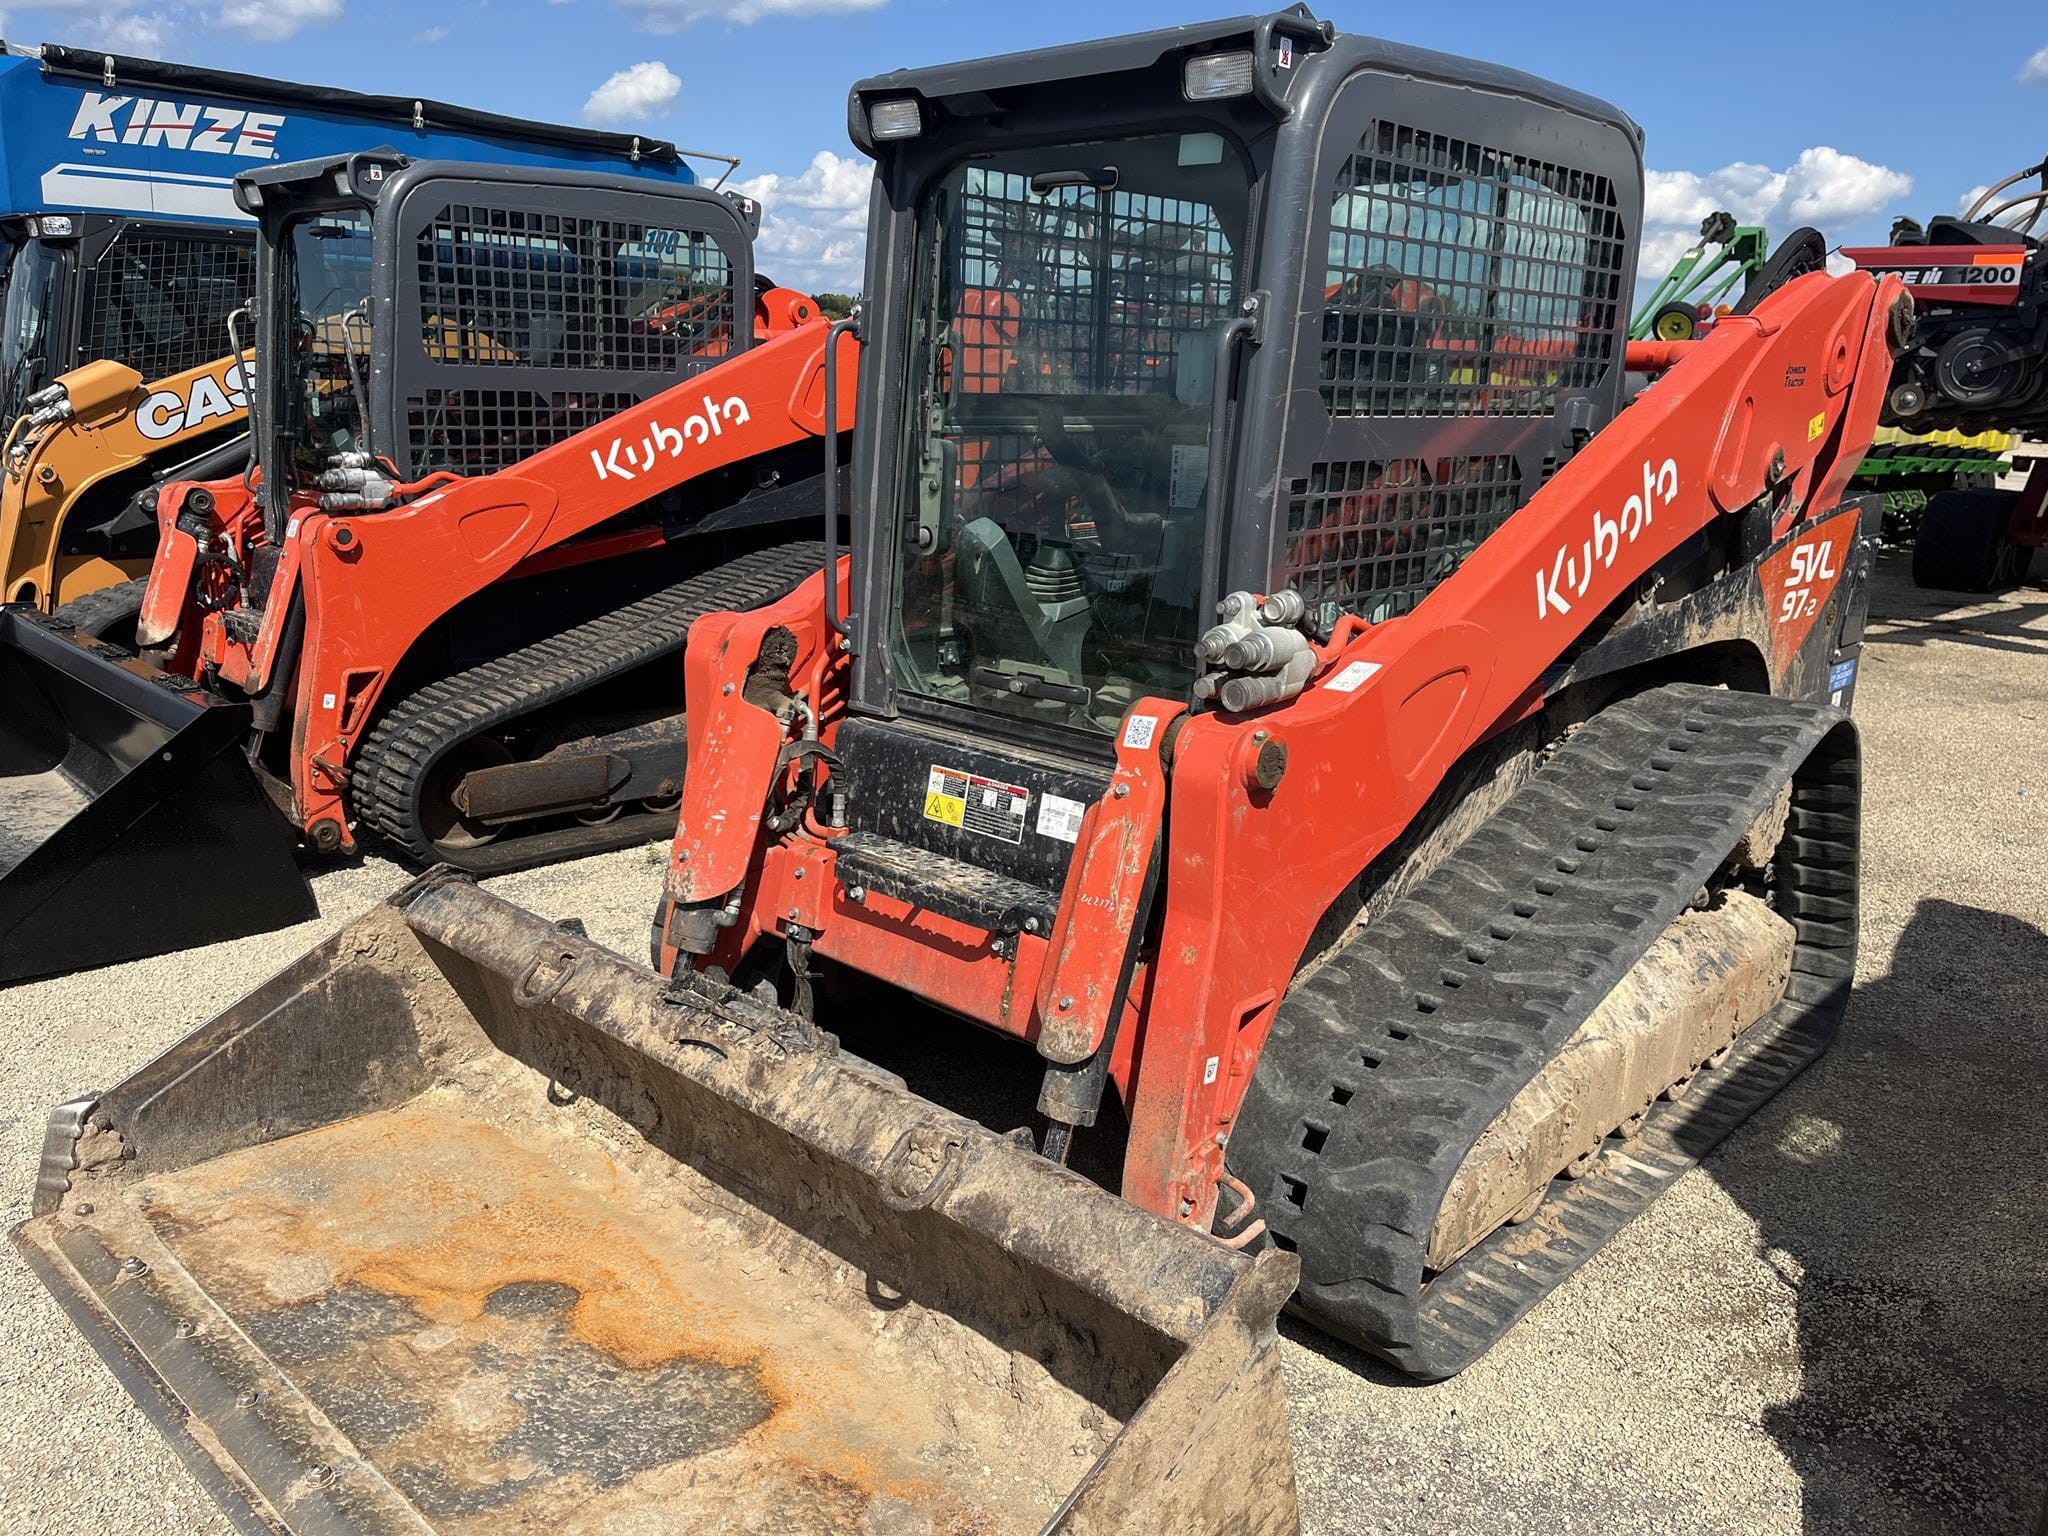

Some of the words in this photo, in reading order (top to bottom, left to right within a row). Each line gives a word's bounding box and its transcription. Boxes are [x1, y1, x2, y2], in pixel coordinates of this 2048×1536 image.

[68, 92, 286, 159] KINZE
[1958, 267, 2015, 284] 1200
[590, 395, 751, 481] Kubota
[1536, 458, 1678, 621] Kubota
[1784, 541, 1836, 588] SVL
[1779, 588, 1817, 623] 97-2
